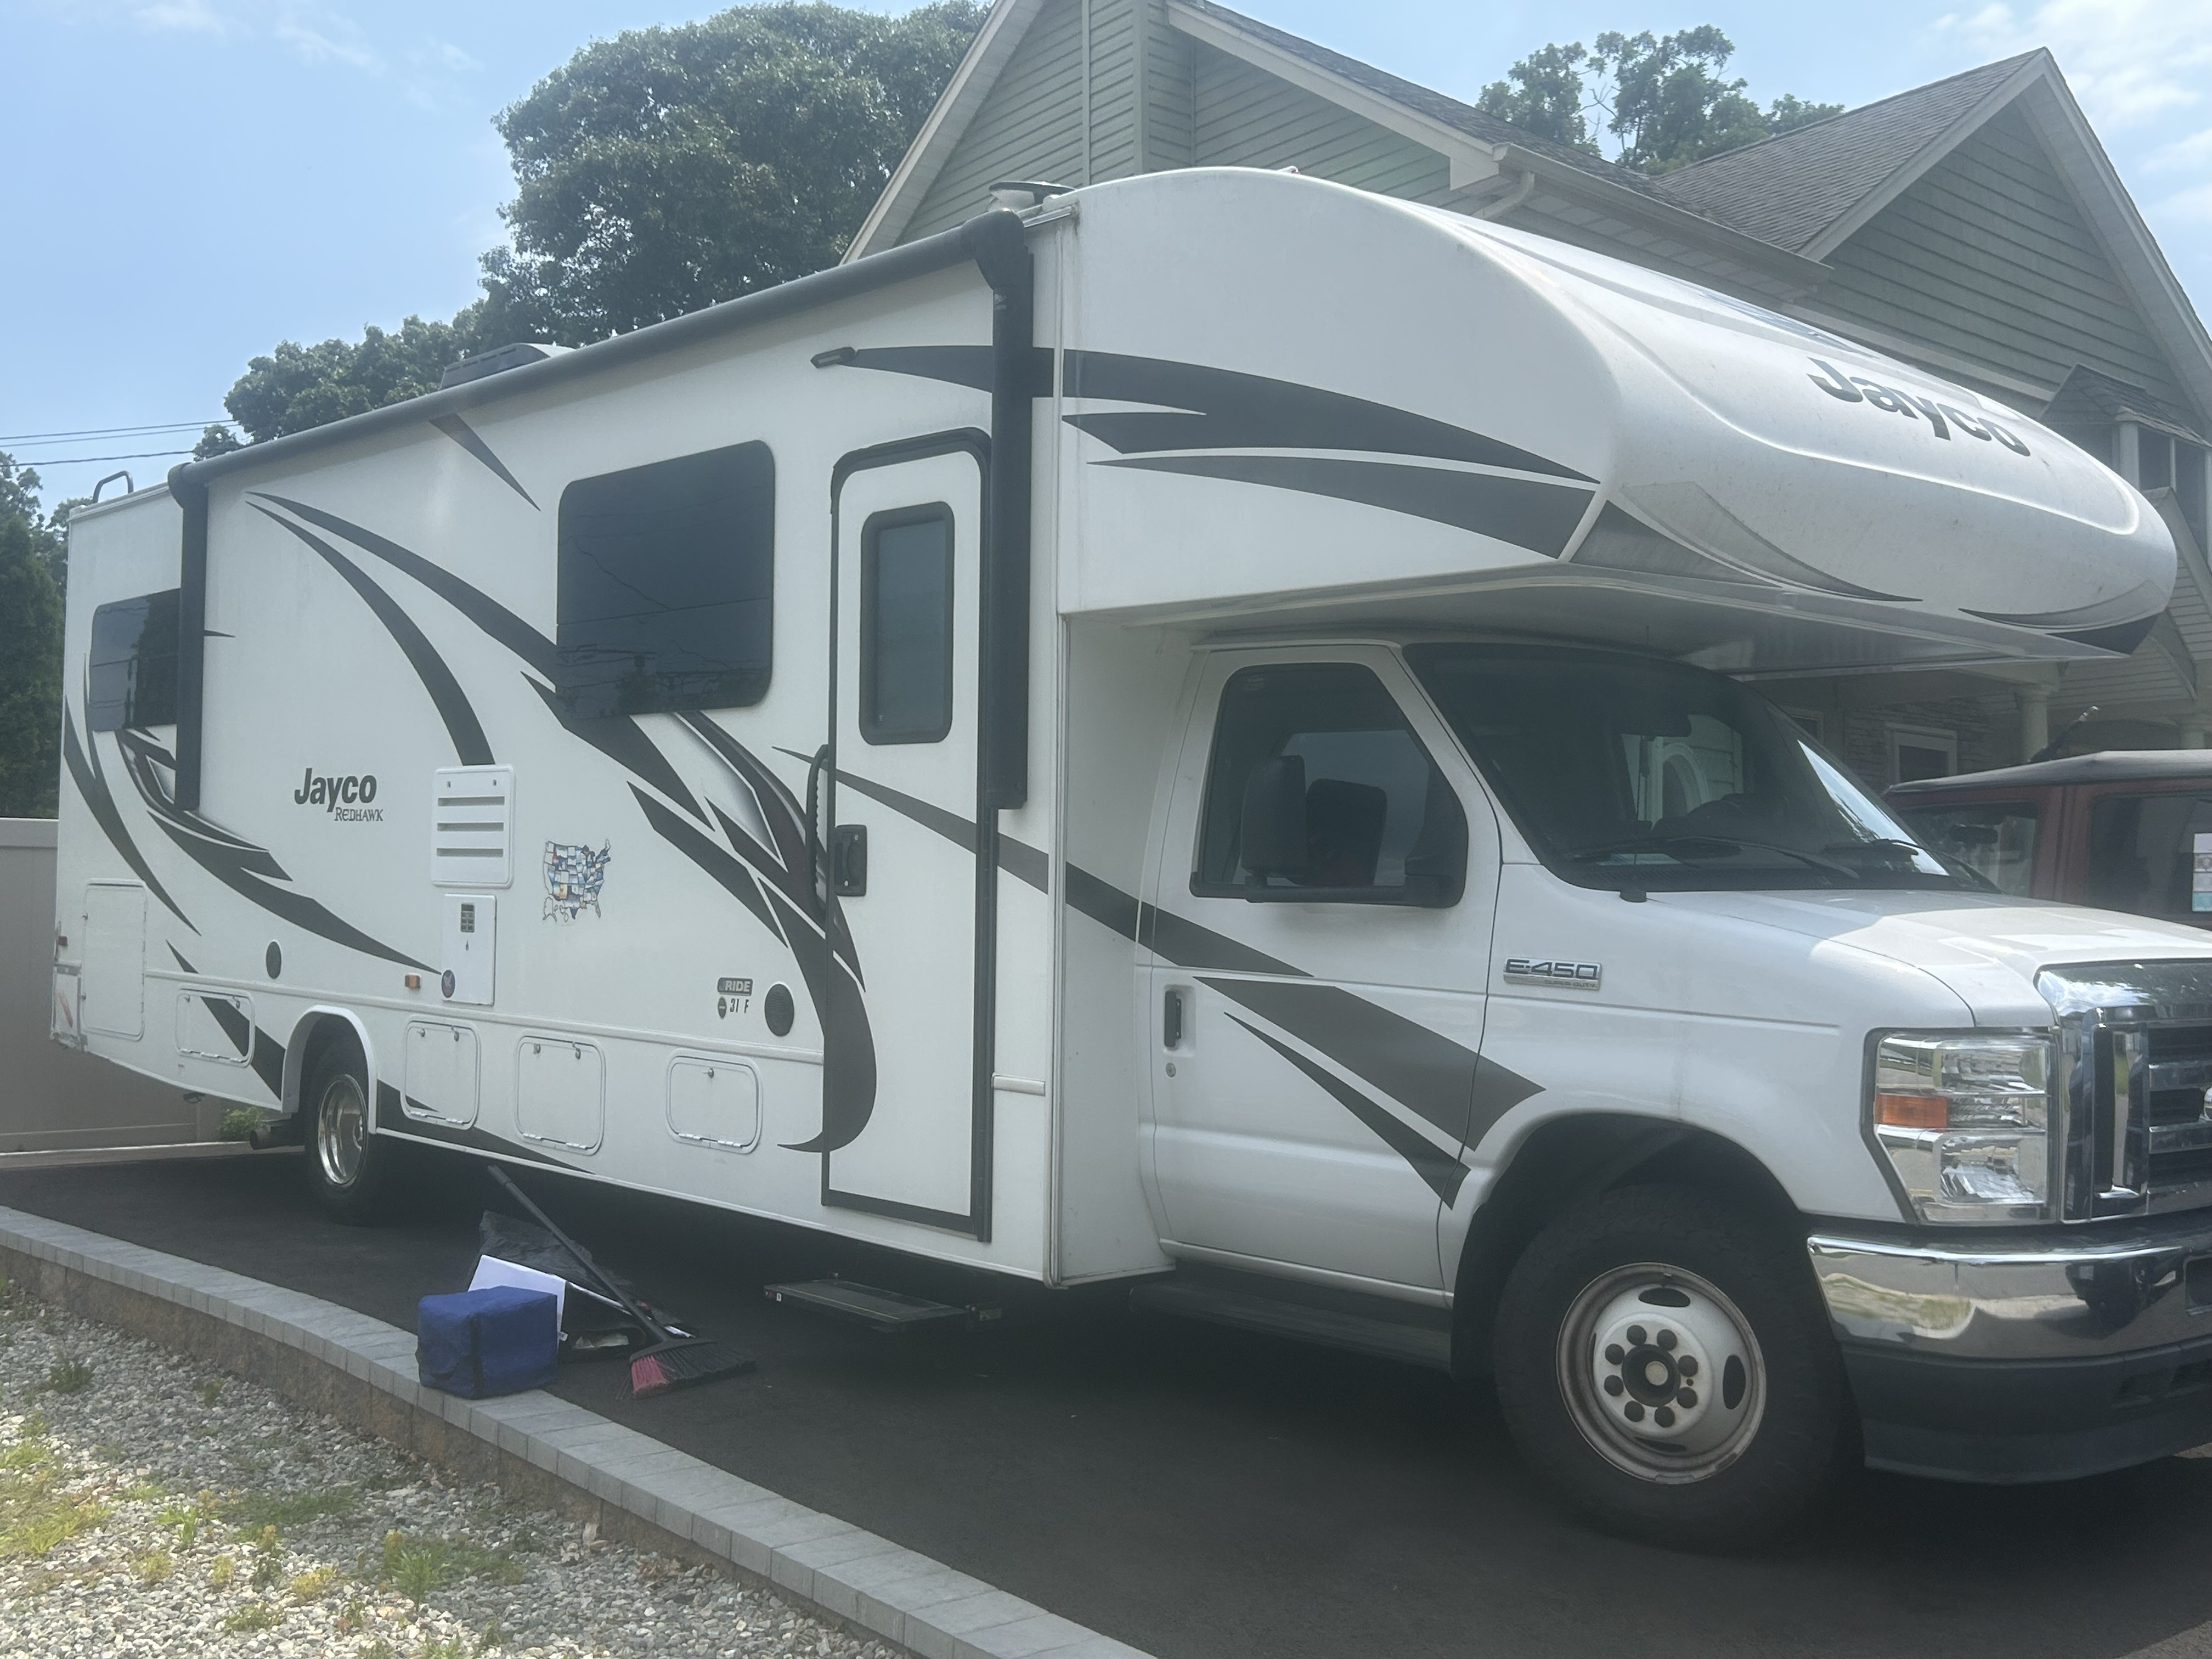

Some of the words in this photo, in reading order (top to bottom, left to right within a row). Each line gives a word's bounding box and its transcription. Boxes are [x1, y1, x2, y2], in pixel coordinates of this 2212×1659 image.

[1806, 356, 2031, 456] Jayco
[294, 768, 377, 812] Jayco
[334, 807, 383, 822] REDHAWK
[1505, 959, 1599, 980] E-450
